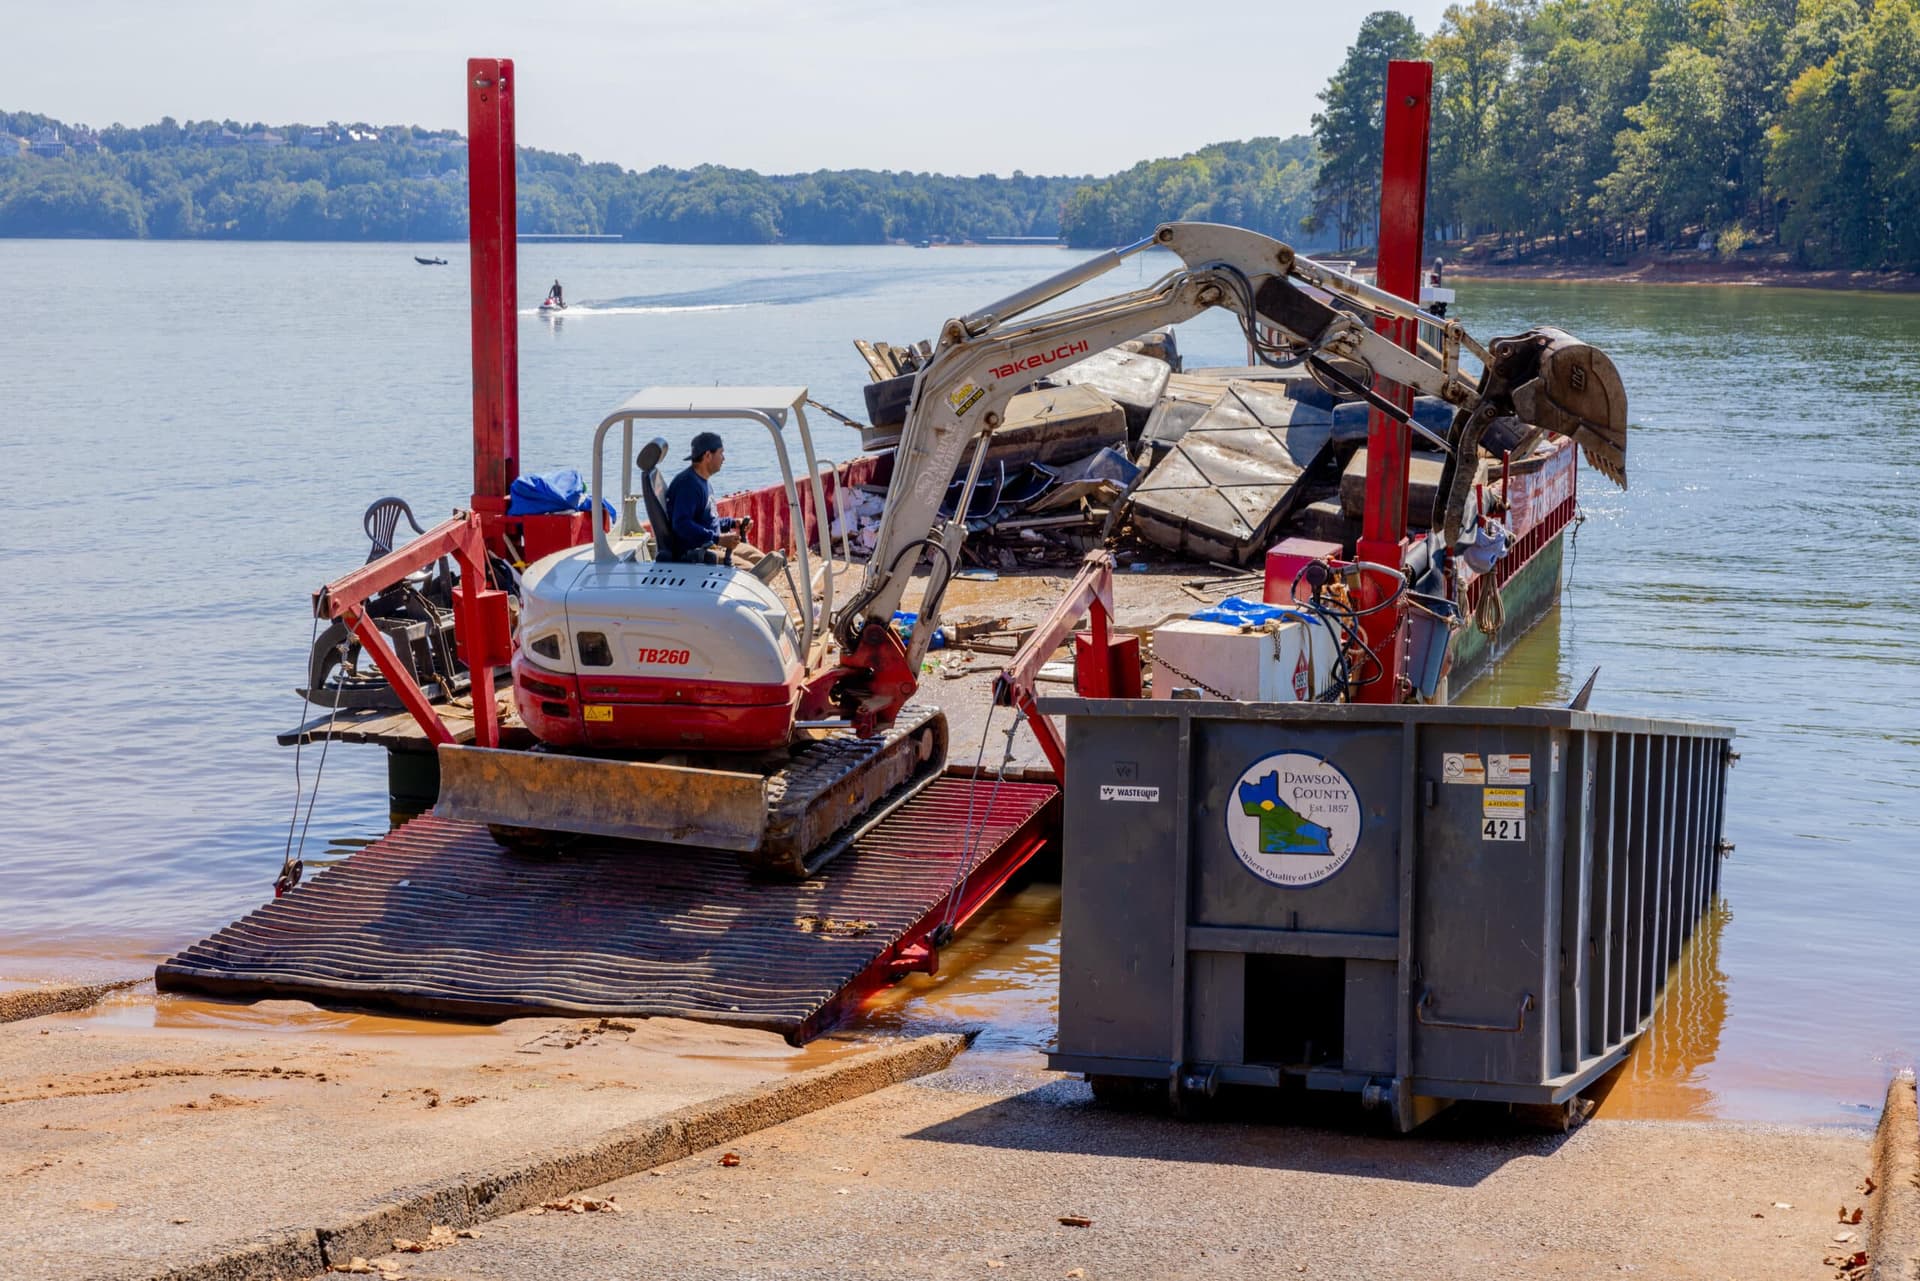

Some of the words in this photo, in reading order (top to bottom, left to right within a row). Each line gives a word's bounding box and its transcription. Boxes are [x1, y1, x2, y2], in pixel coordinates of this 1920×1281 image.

[988, 339, 1089, 379] TAKEUCHI
[638, 648, 690, 665] TB260
[1117, 788, 1158, 798] WASTEQUIP
[1309, 804, 1326, 813] Est.
[1328, 804, 1349, 813] 1857
[1484, 820, 1522, 839] 421
[1265, 869, 1296, 883] Quality
[1309, 869, 1325, 880] Life
